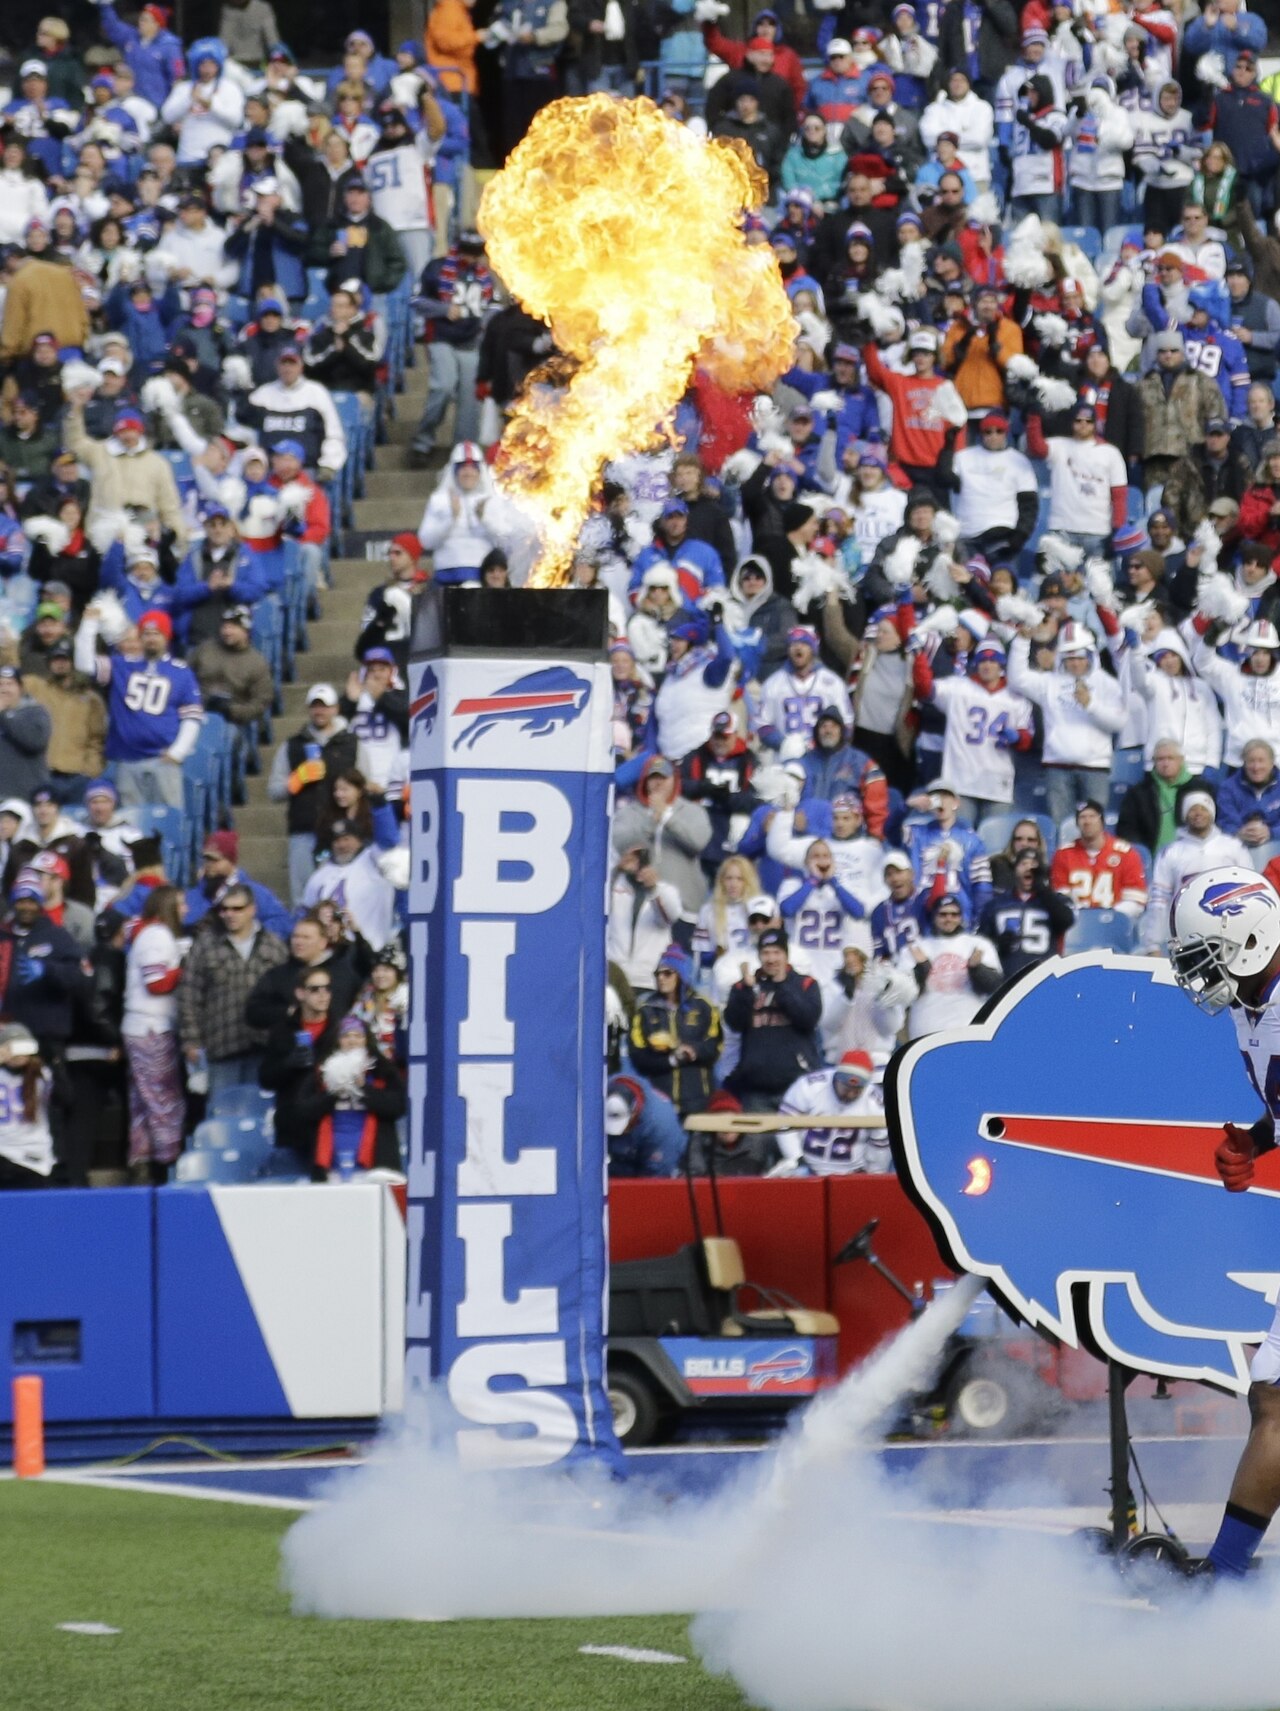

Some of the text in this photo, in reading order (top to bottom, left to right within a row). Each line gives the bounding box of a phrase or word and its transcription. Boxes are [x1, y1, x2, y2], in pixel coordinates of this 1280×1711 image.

[371, 155, 403, 191] 51
[1184, 341, 1223, 378] 99
[127, 671, 172, 716] 50
[784, 697, 826, 735] 83
[966, 705, 1010, 750] 34
[1070, 871, 1116, 909] 24
[799, 909, 842, 951] 22
[447, 776, 577, 1470] BILLS
[805, 1127, 860, 1162] 22
[683, 1358, 747, 1379] BILLS
